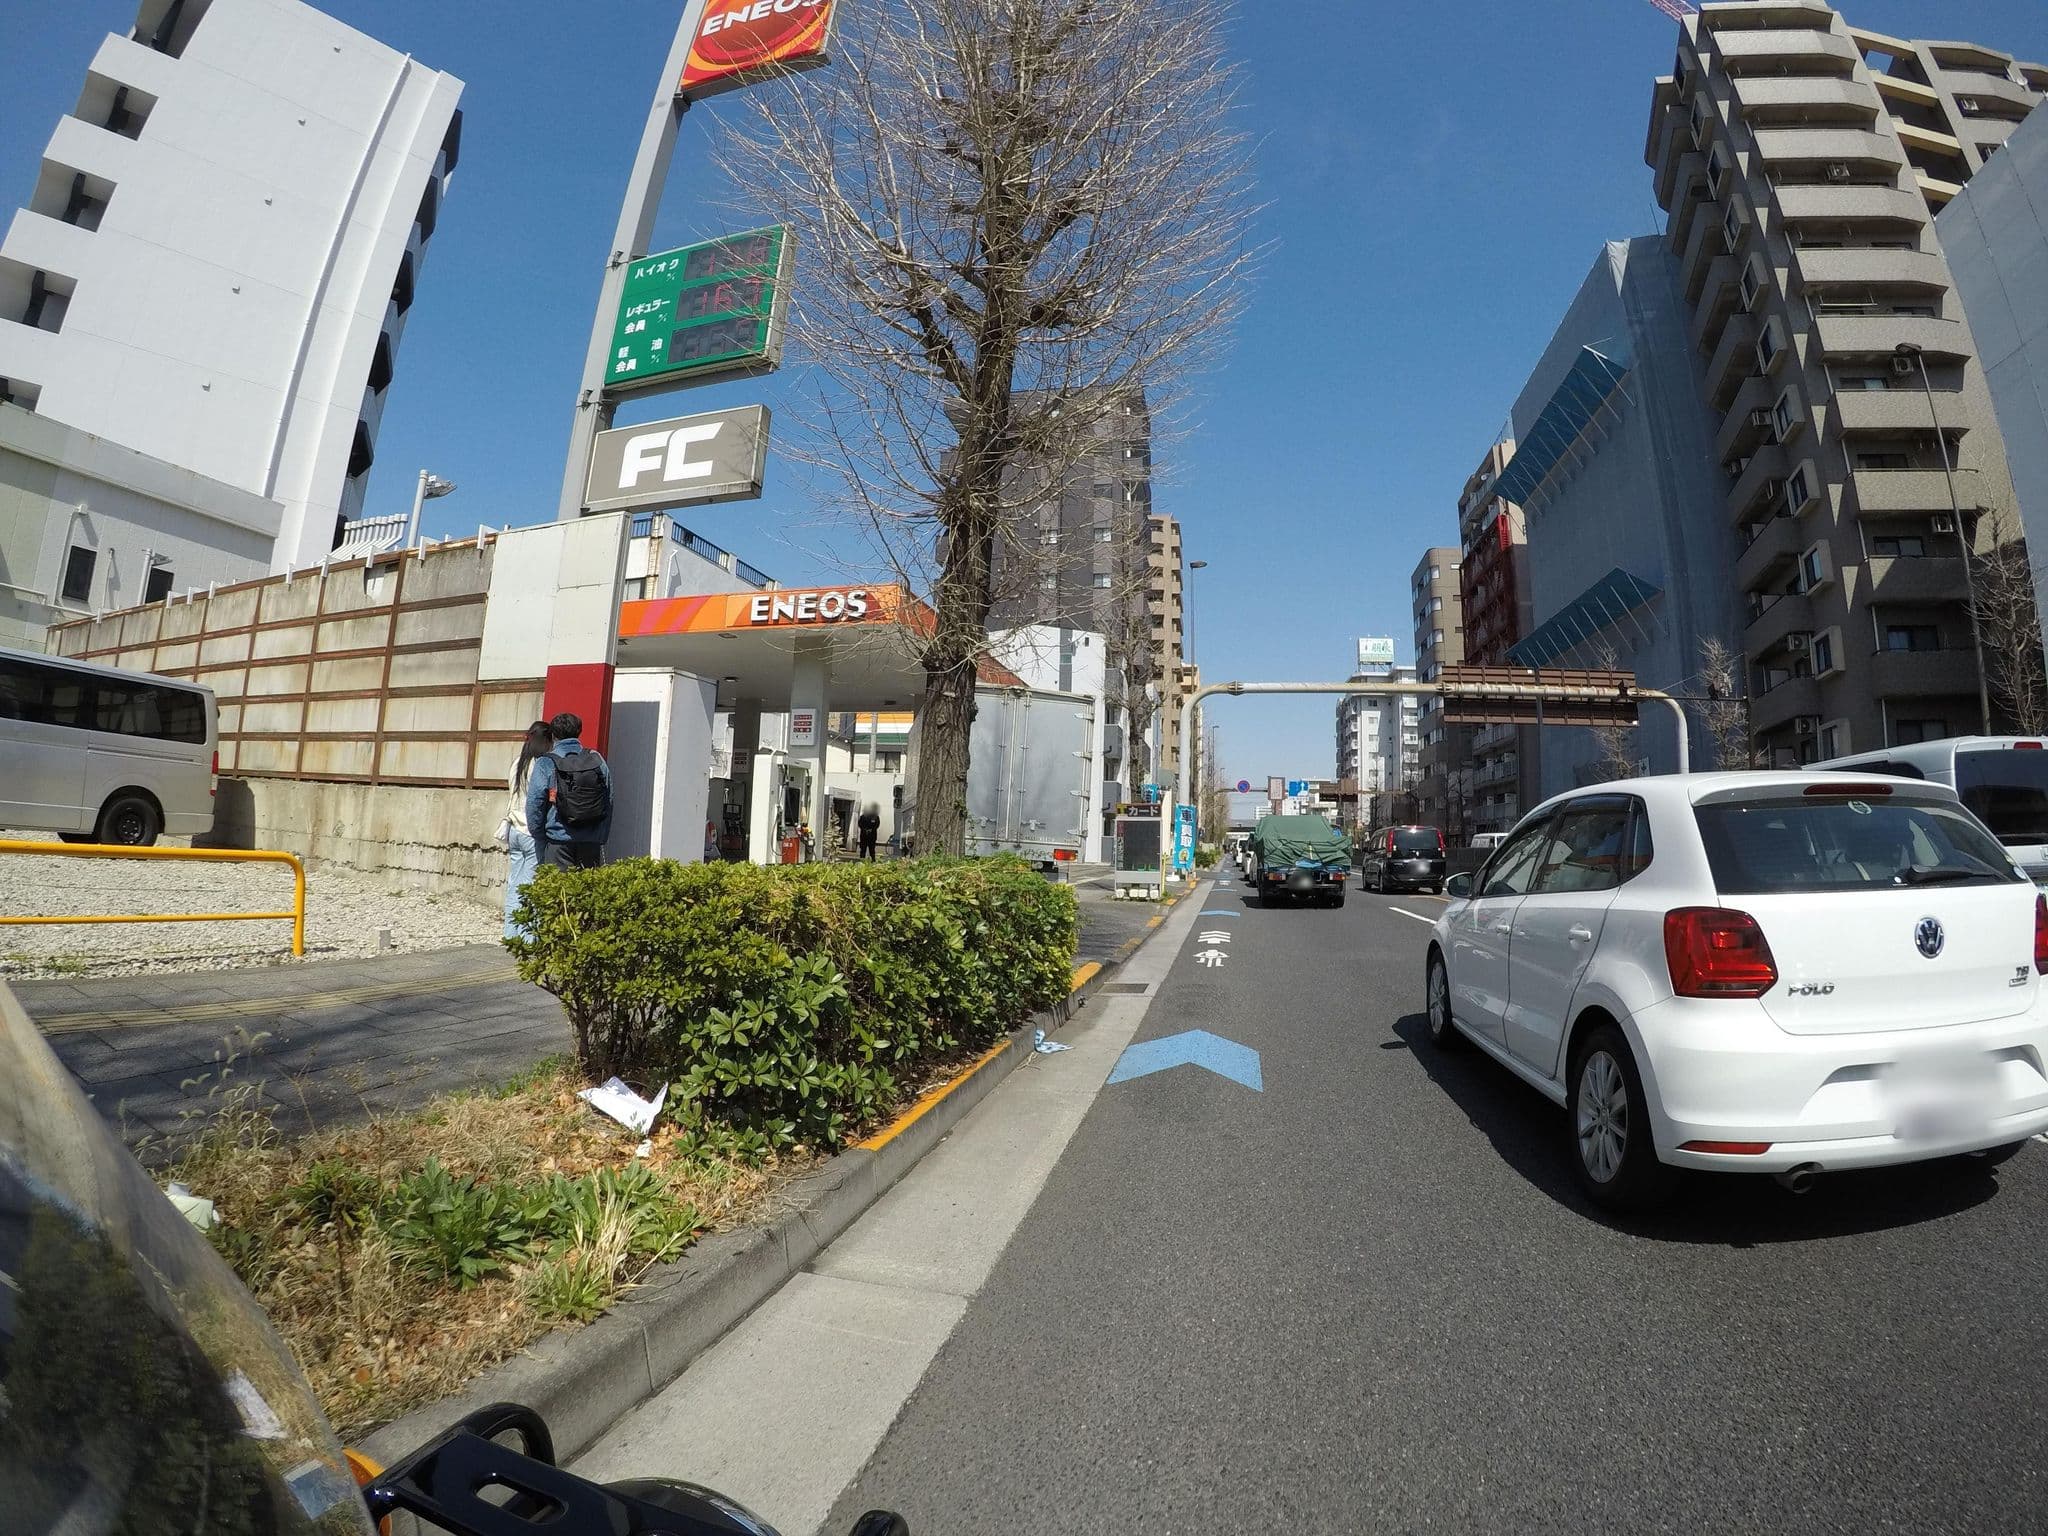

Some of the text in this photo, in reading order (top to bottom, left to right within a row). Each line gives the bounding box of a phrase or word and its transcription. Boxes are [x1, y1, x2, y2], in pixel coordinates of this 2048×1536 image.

[701, 0, 820, 37] ENEO
[634, 258, 679, 280] ハイオク
[626, 300, 671, 318] レギュラー
[618, 421, 724, 489] FC
[750, 589, 867, 622] ENEOS
[1787, 982, 1835, 997] POLO
